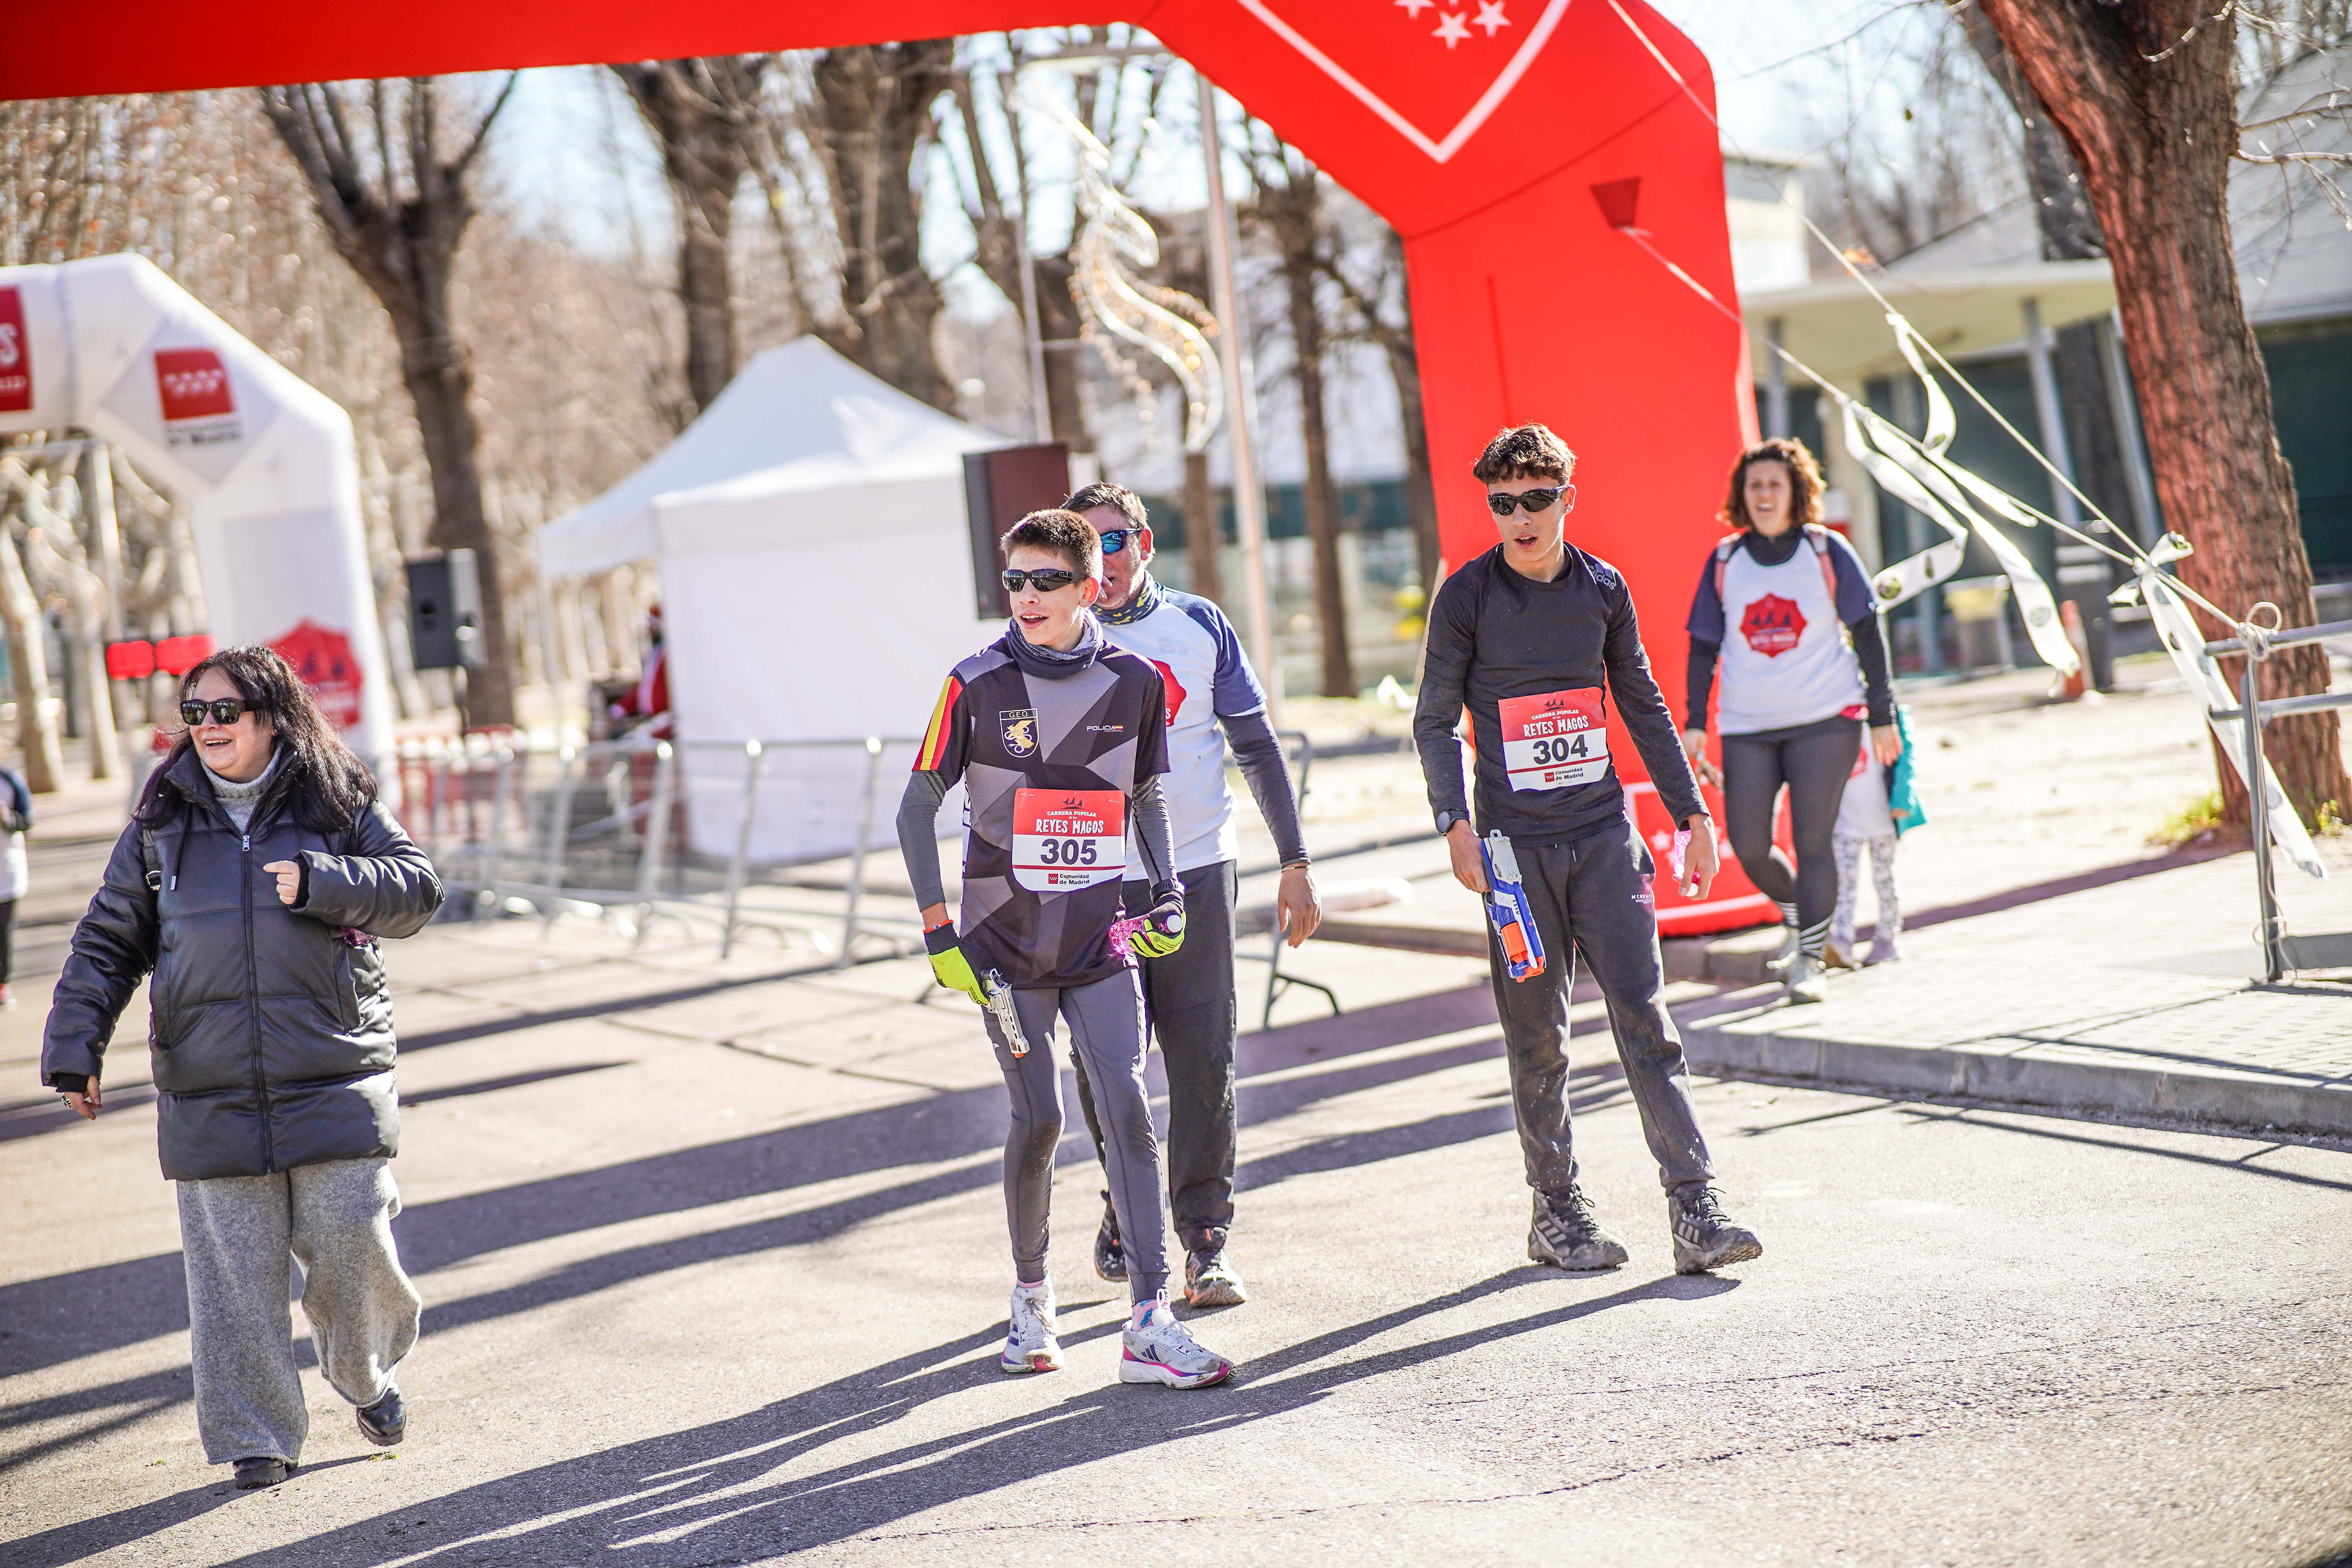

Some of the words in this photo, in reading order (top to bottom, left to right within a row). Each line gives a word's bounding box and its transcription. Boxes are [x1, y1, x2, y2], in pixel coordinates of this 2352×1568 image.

[1591, 569, 1616, 590] idas
[1523, 721, 1554, 737] REYES
[1557, 715, 1589, 733] MAGOS
[1532, 711, 1556, 720] CARRERA
[1533, 734, 1588, 764] 304
[1036, 818, 1069, 833] REYES
[1072, 820, 1104, 834] MAGOS
[1040, 838, 1097, 865] 305
